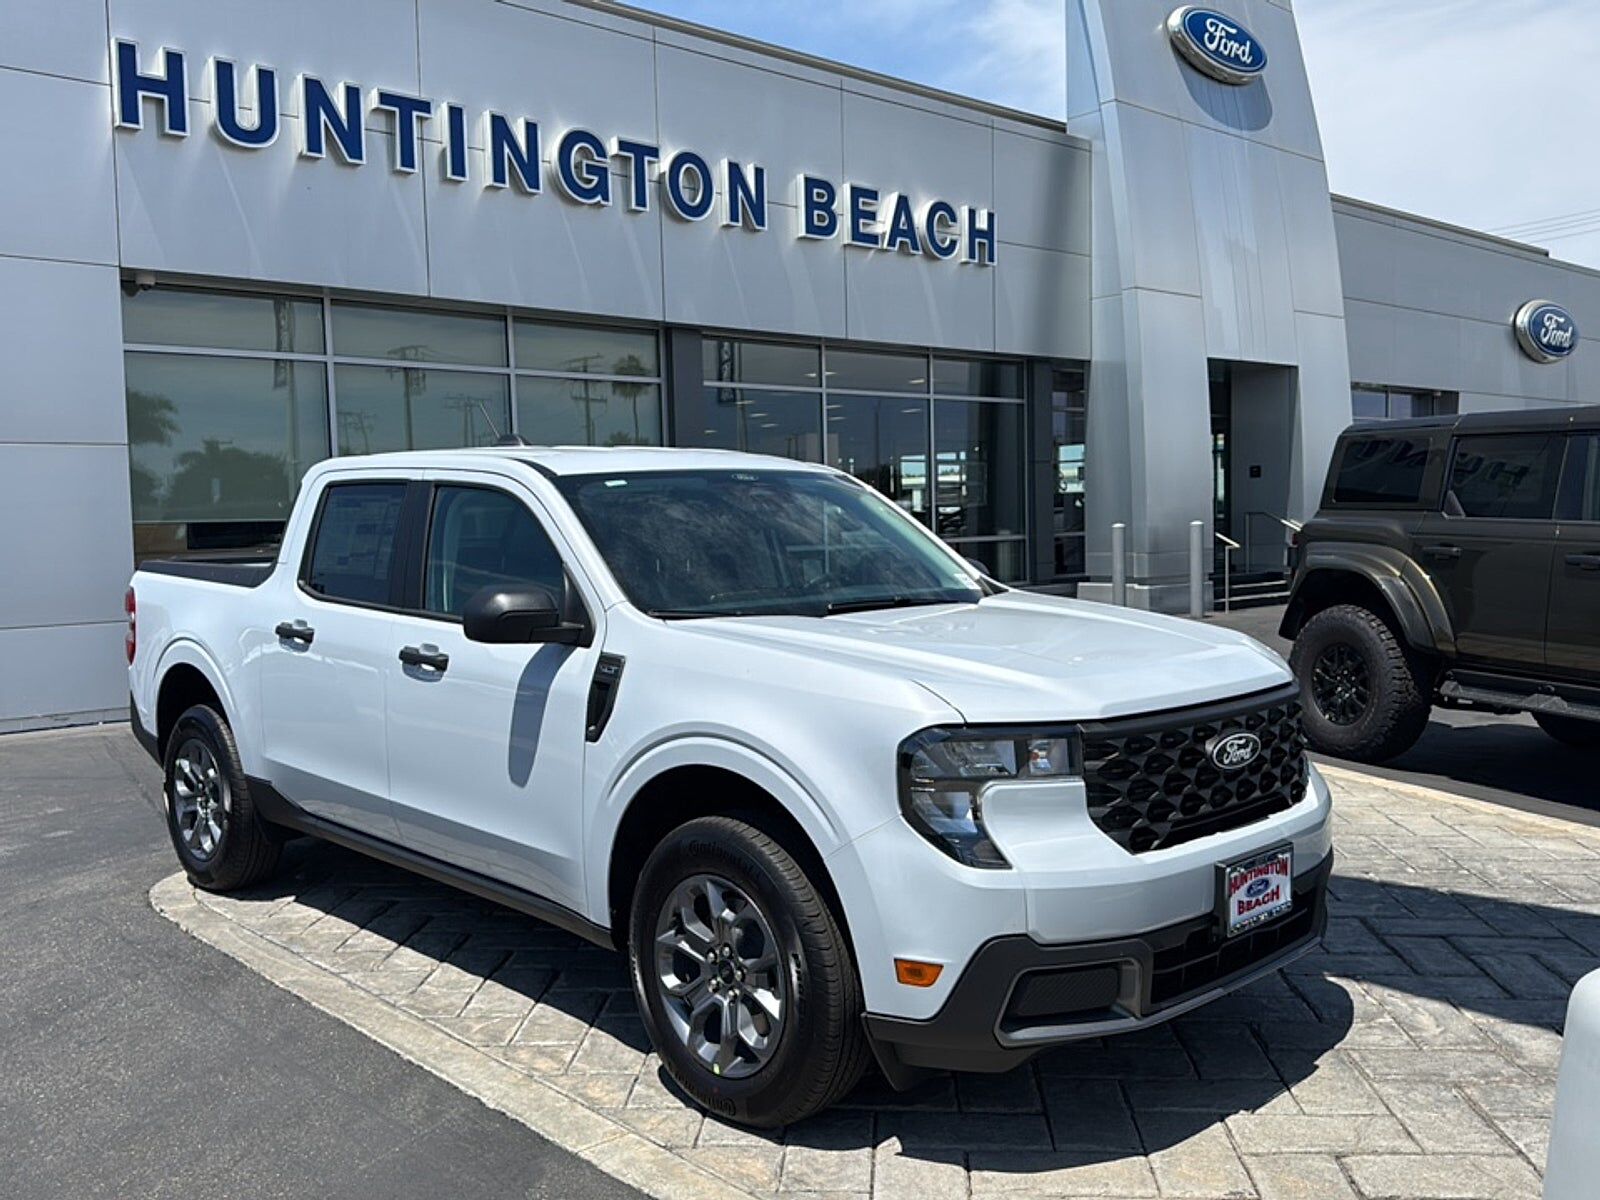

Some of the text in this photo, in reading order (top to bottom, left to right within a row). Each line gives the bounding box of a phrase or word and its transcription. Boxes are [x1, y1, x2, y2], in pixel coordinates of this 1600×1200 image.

[1203, 17, 1254, 65] Ford
[114, 38, 998, 266] HUNTINGTON BEACH
[1540, 313, 1574, 348] Ford
[1223, 738, 1254, 765] Ford
[1229, 857, 1290, 898] HUNTINGTON
[1236, 884, 1281, 916] BEACH
